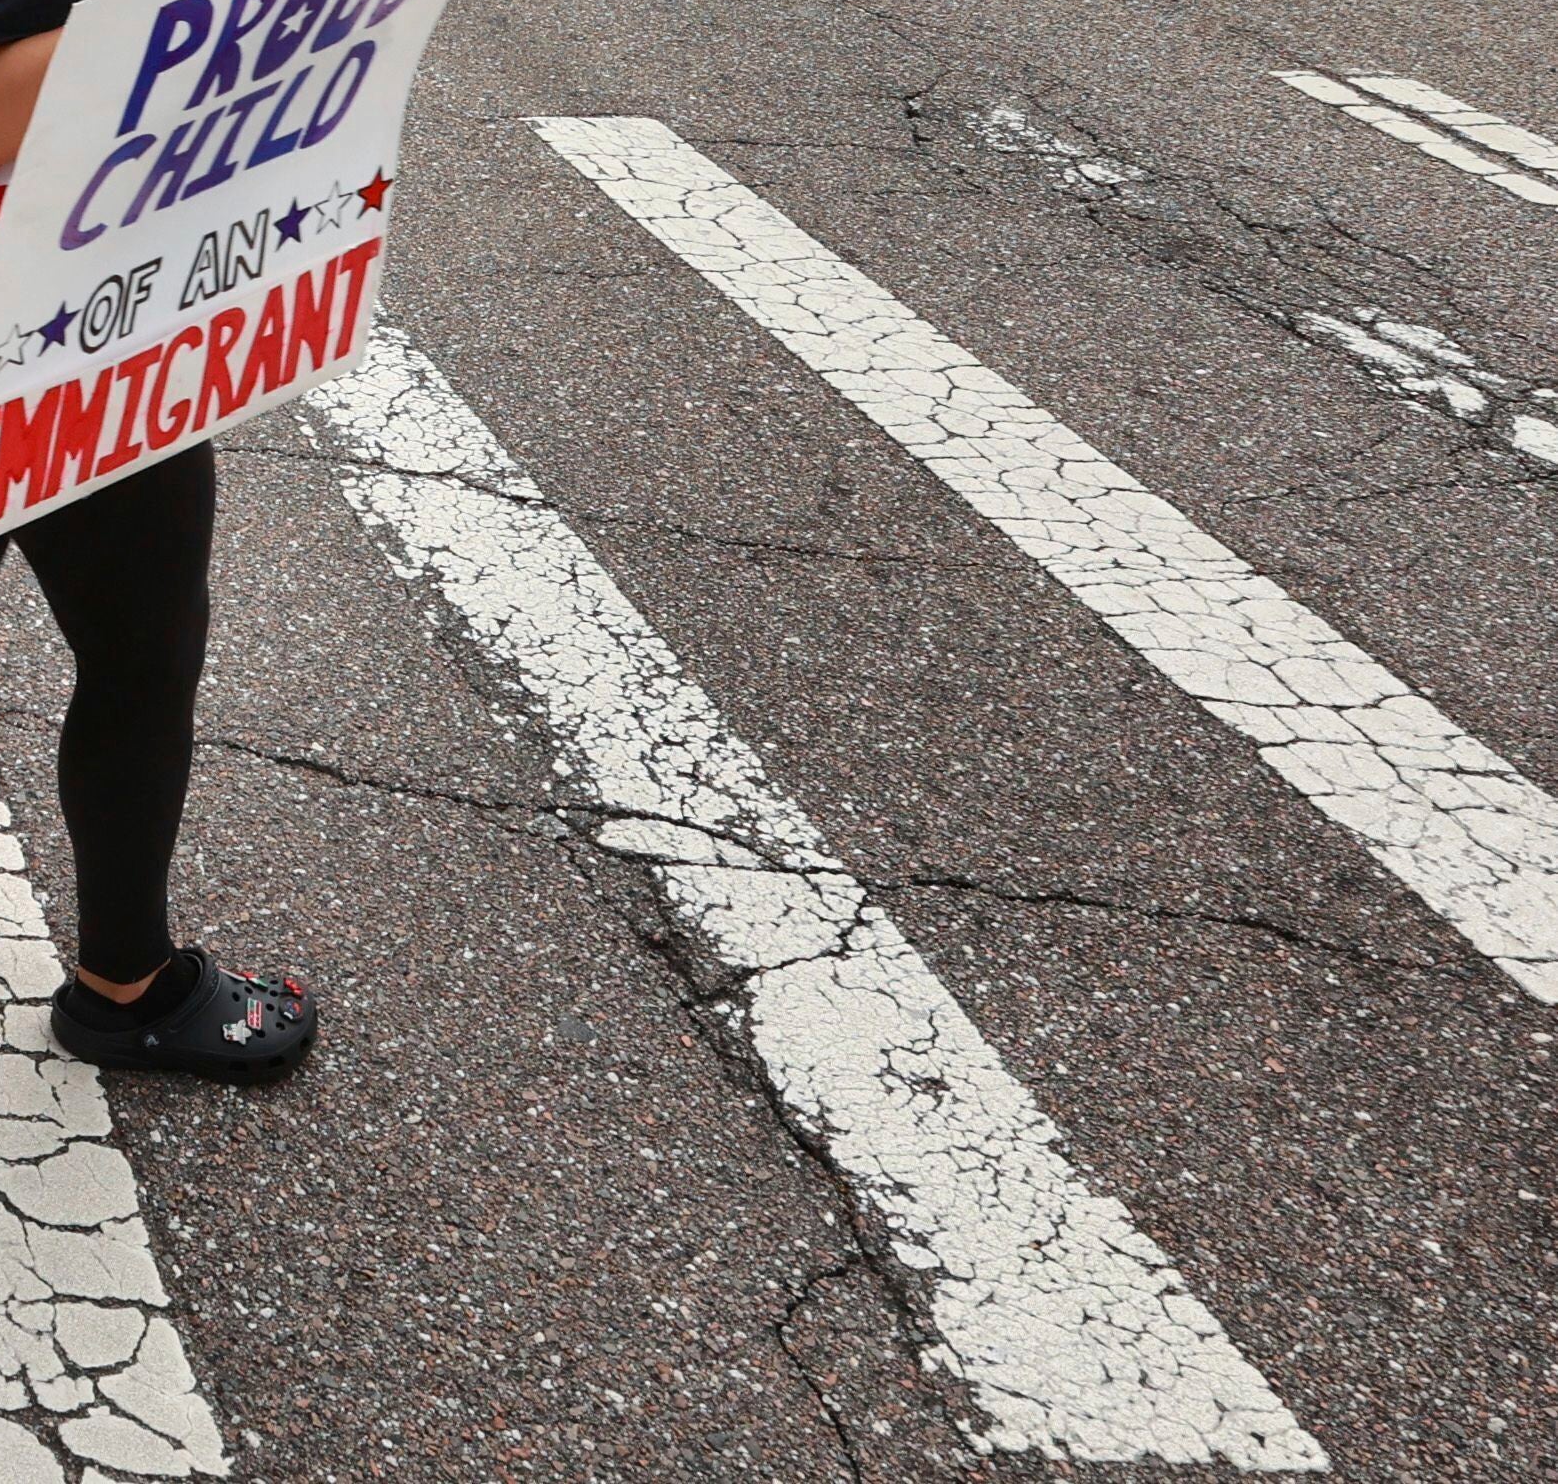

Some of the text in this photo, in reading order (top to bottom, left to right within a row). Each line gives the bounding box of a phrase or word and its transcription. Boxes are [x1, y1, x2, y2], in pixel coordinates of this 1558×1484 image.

[59, 40, 377, 251] CHILD
[79, 208, 271, 354] OF AN
